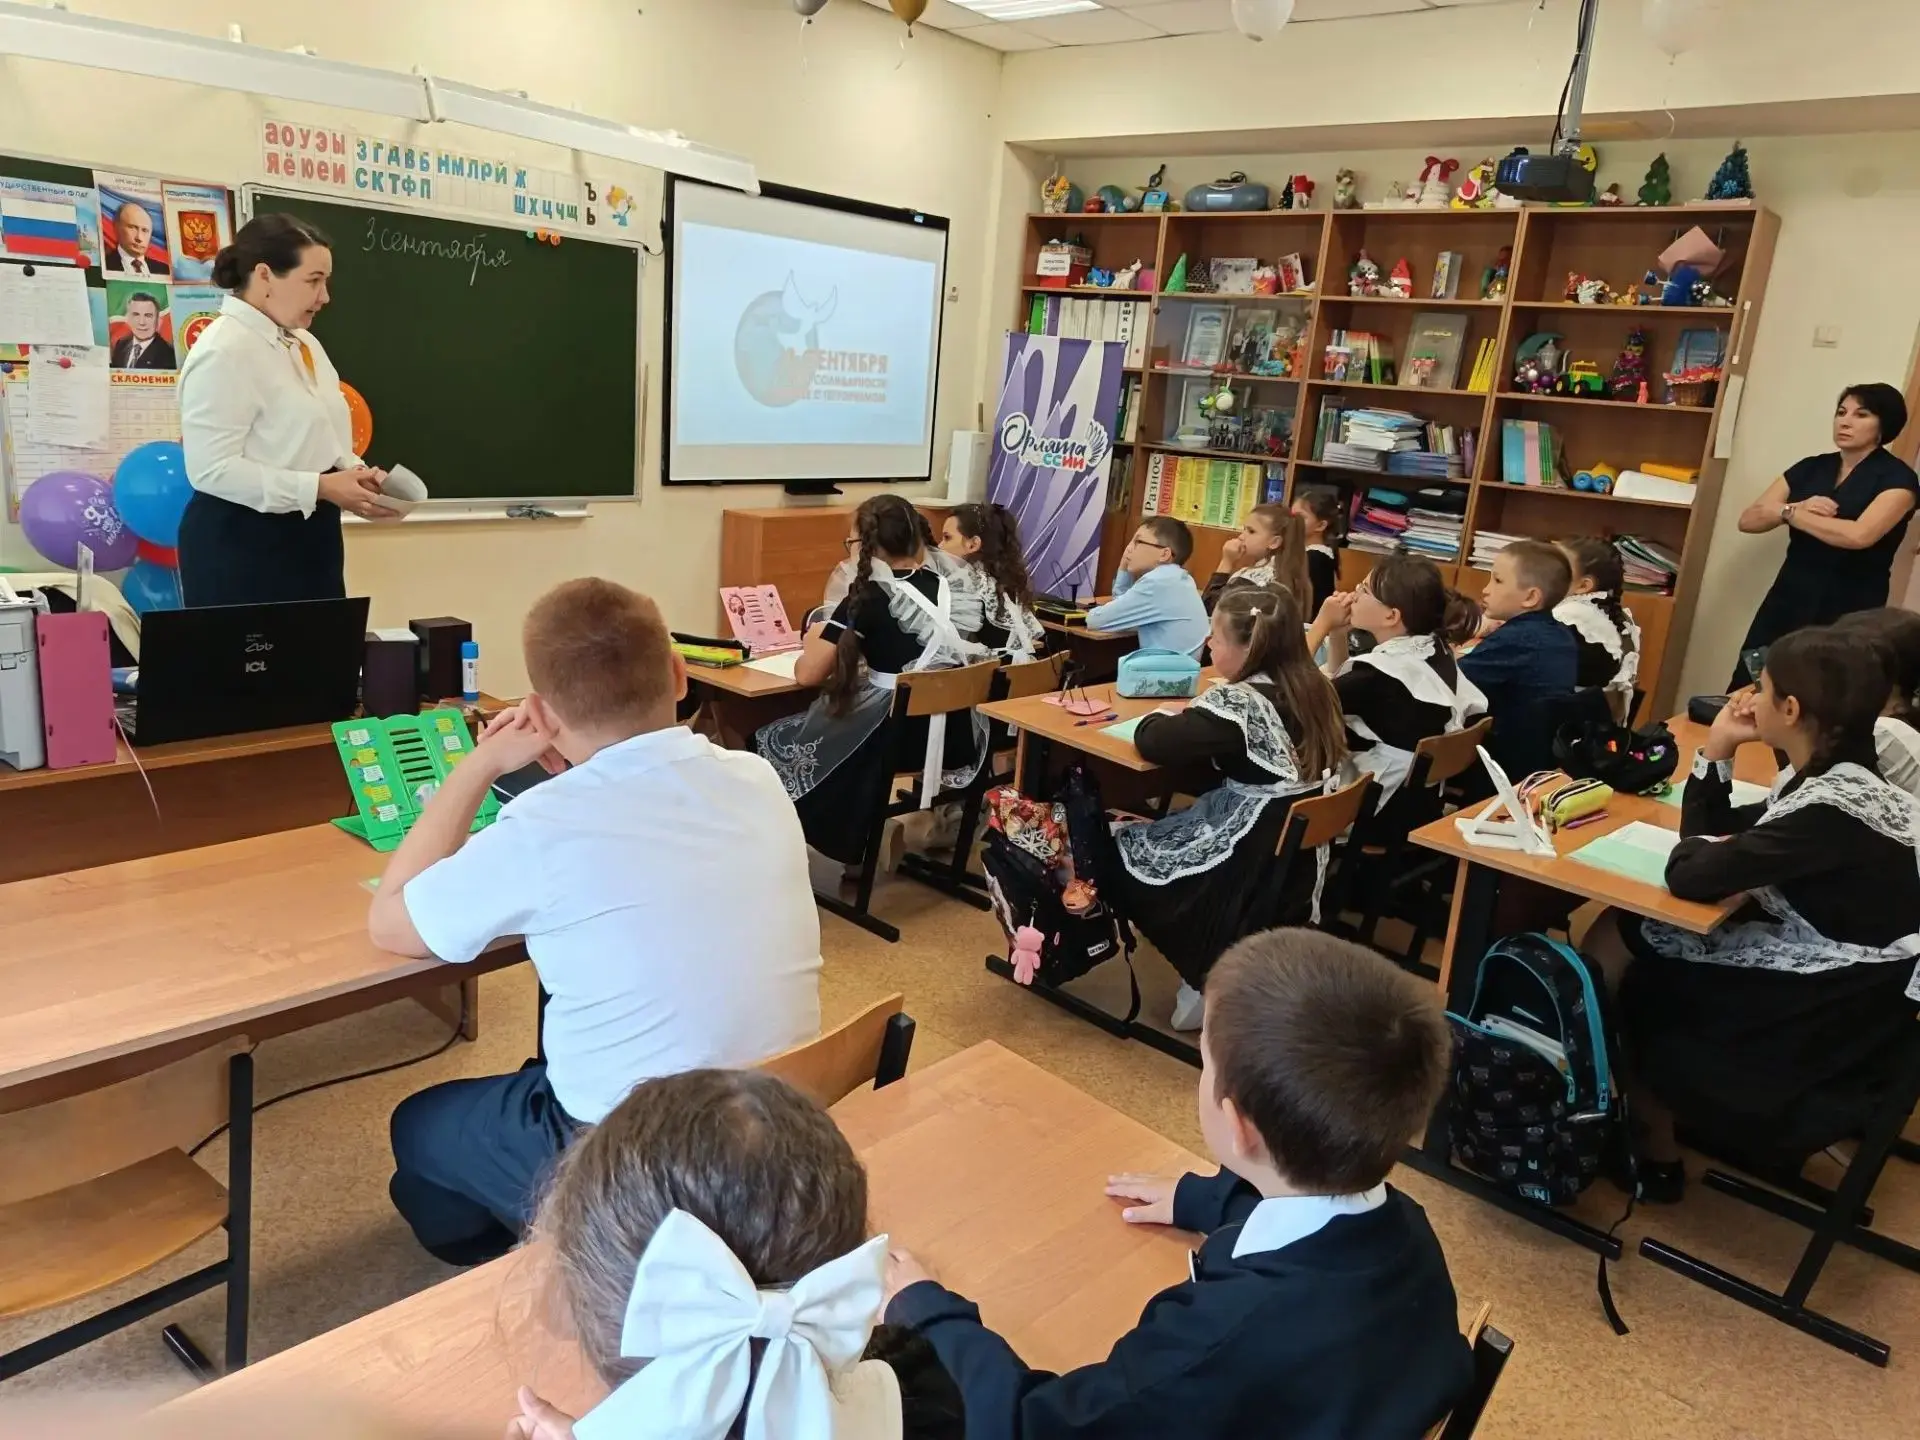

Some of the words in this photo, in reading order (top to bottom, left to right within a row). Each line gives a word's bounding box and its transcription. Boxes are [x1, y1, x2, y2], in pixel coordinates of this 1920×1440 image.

[362, 216, 376, 251] 3
[380, 228, 512, 286] сентября
[111, 373, 176, 385] СКЛОНЕНИЯ
[808, 349, 888, 374] ЕНТЯБРЯ
[1003, 413, 1088, 458] Орлята
[1034, 453, 1085, 470] ССИИ
[1144, 456, 1161, 511] Разное
